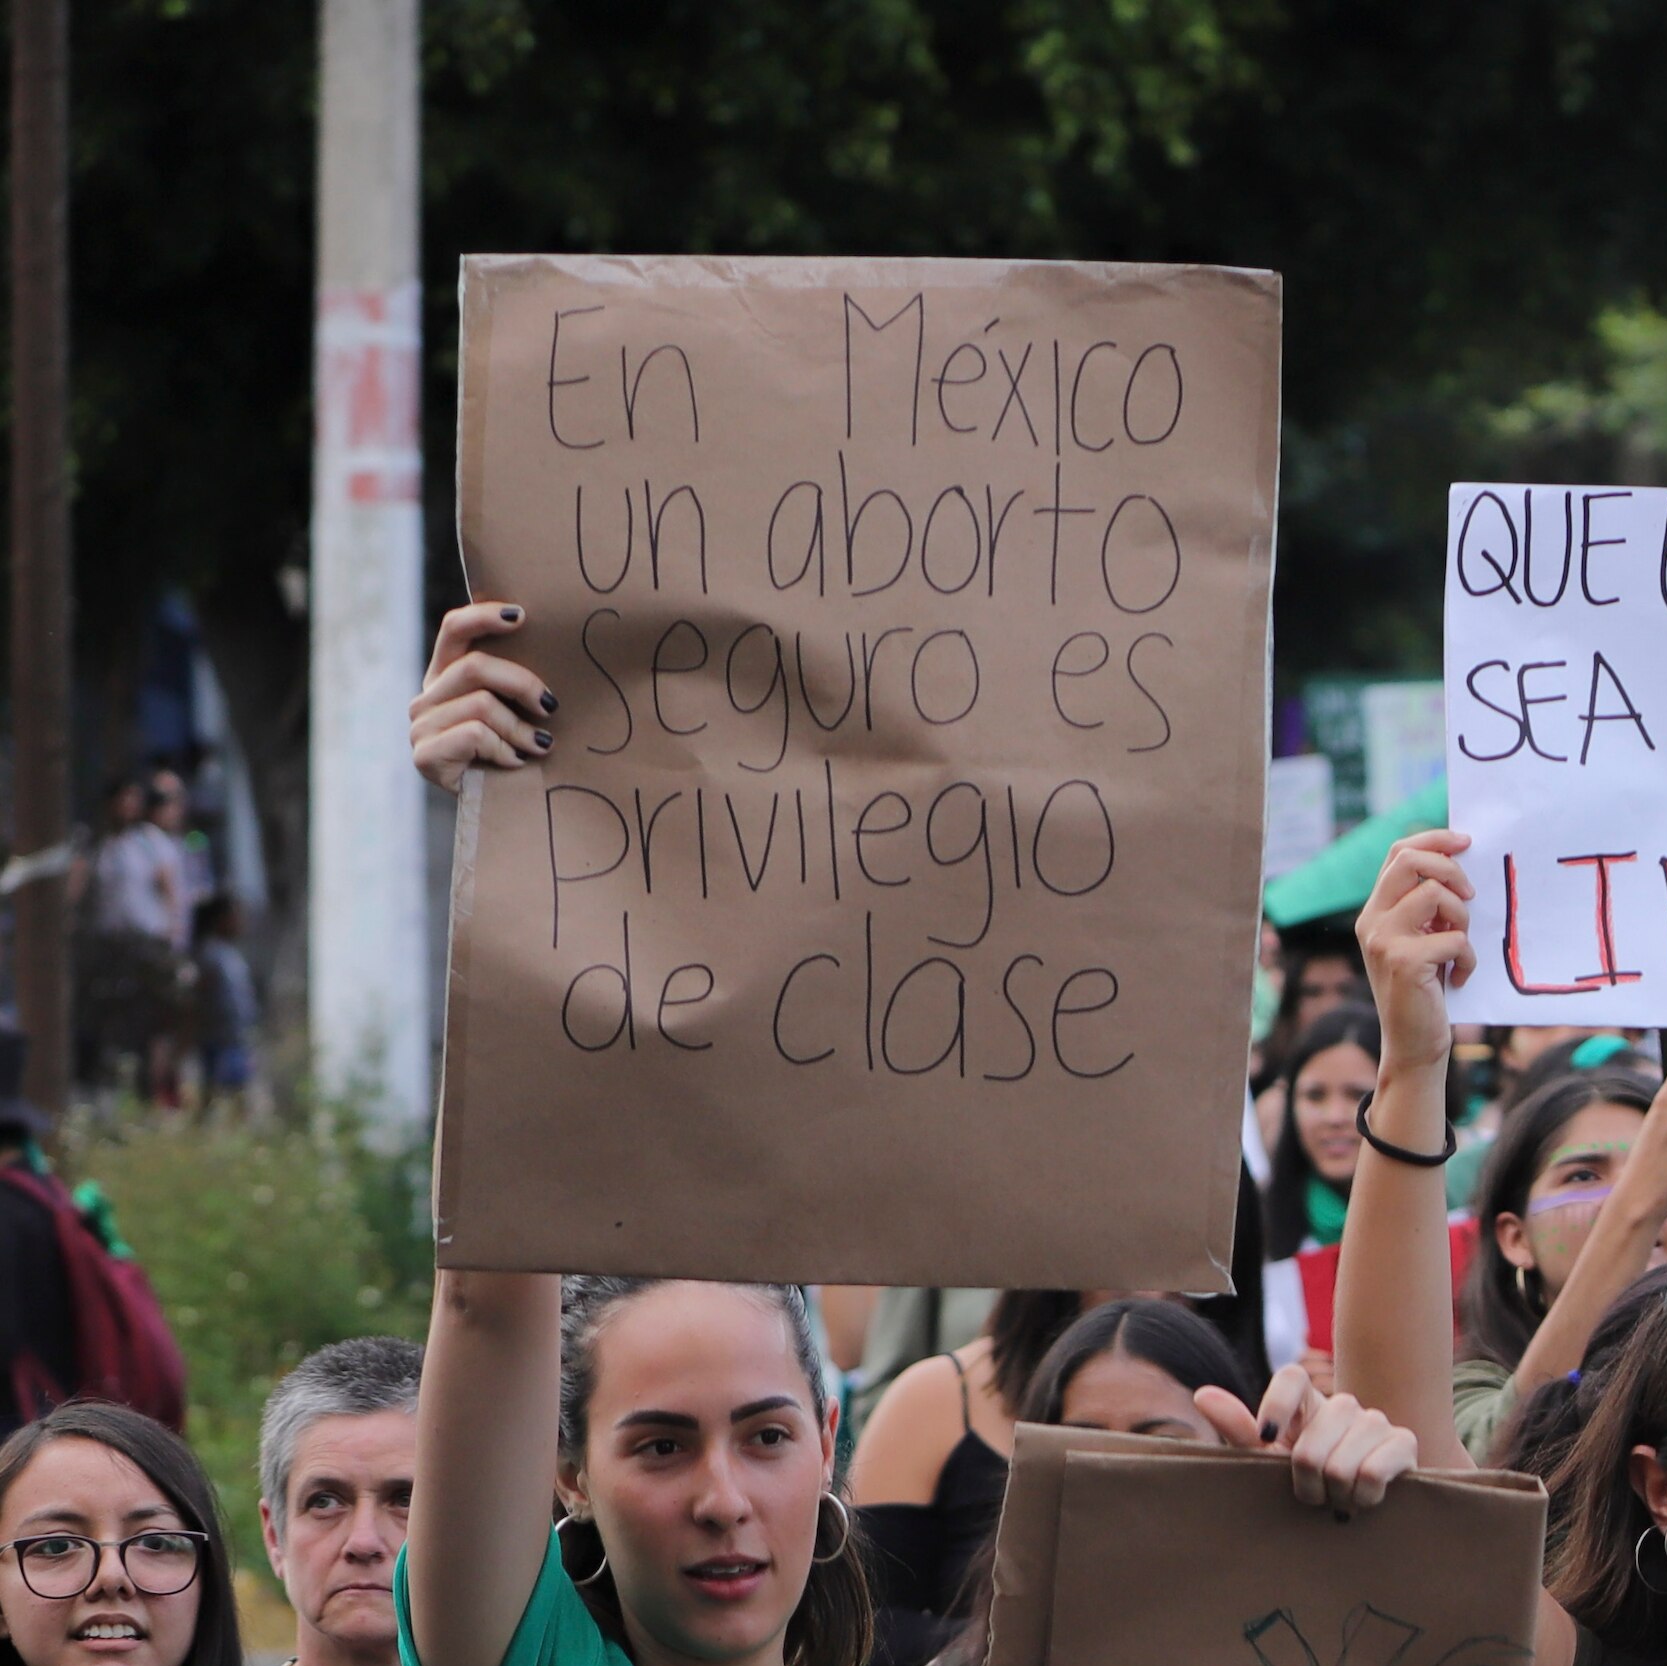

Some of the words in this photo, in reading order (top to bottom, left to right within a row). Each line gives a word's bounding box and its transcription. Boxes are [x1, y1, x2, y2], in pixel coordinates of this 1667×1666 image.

[547, 305, 698, 450] En
[844, 292, 1183, 456] México
[576, 478, 708, 595] un
[767, 451, 1181, 615] aborto
[1456, 489, 1633, 608] QUE
[582, 608, 981, 773] seguro
[1052, 631, 1175, 753] es
[1457, 651, 1656, 766] SEA
[546, 759, 1115, 950] privilegio
[561, 910, 715, 1052] de
[773, 910, 1135, 1081] clase
